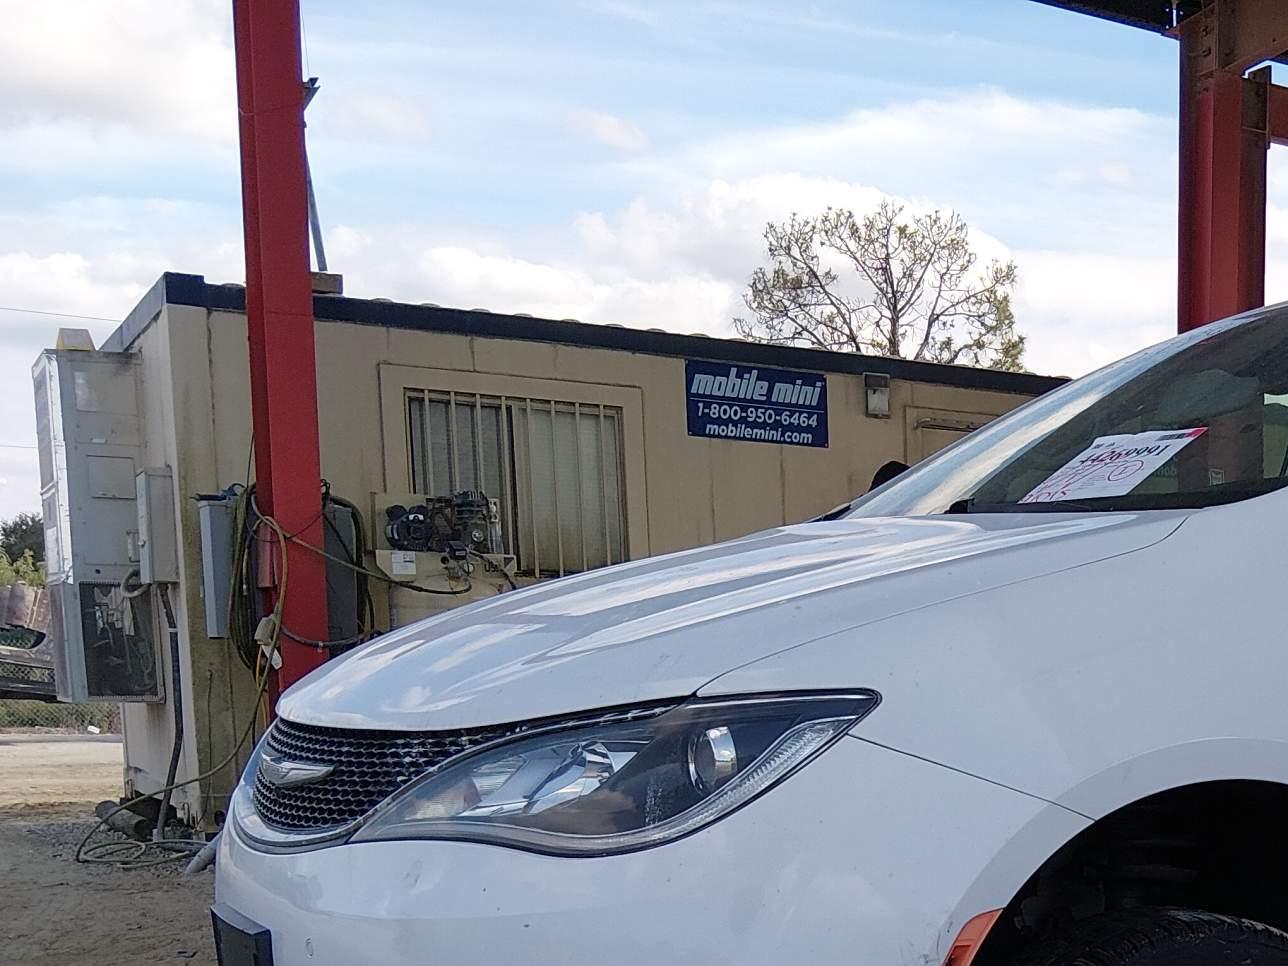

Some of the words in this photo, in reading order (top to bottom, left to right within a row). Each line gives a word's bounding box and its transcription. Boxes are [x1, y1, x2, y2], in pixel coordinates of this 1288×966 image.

[691, 368, 769, 400] mobile
[772, 380, 822, 405] mini
[698, 403, 818, 427] 1-800-950-6464
[706, 424, 812, 443] mobilemini.com
